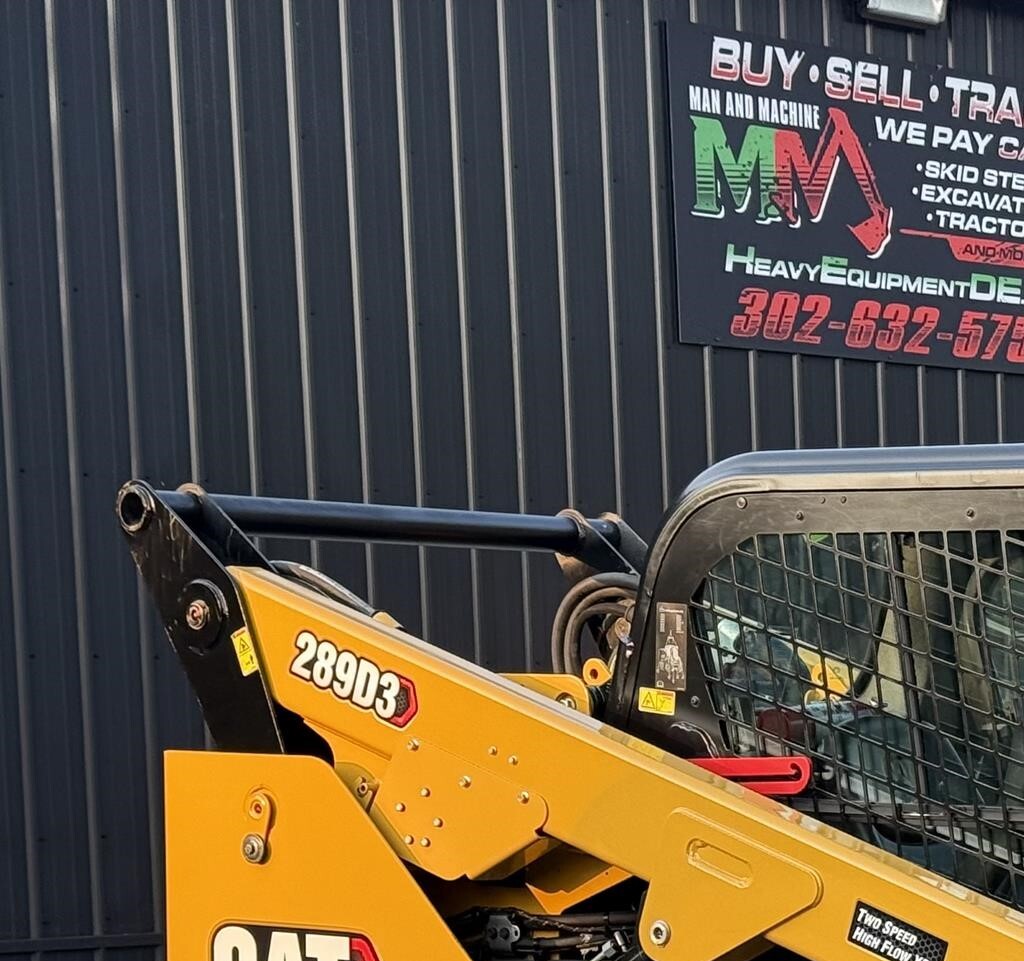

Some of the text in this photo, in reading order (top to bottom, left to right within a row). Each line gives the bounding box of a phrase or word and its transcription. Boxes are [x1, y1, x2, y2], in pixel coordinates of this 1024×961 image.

[710, 35, 805, 91] BUY
[824, 55, 924, 112] SELL
[688, 85, 821, 130] MAN AND MACHINE
[875, 116, 928, 146] WE
[932, 125, 994, 155] PAY
[924, 160, 979, 184] SKID
[290, 631, 401, 719] 289D3
[852, 926, 881, 949] HIGH
[882, 921, 918, 946] SPEED
